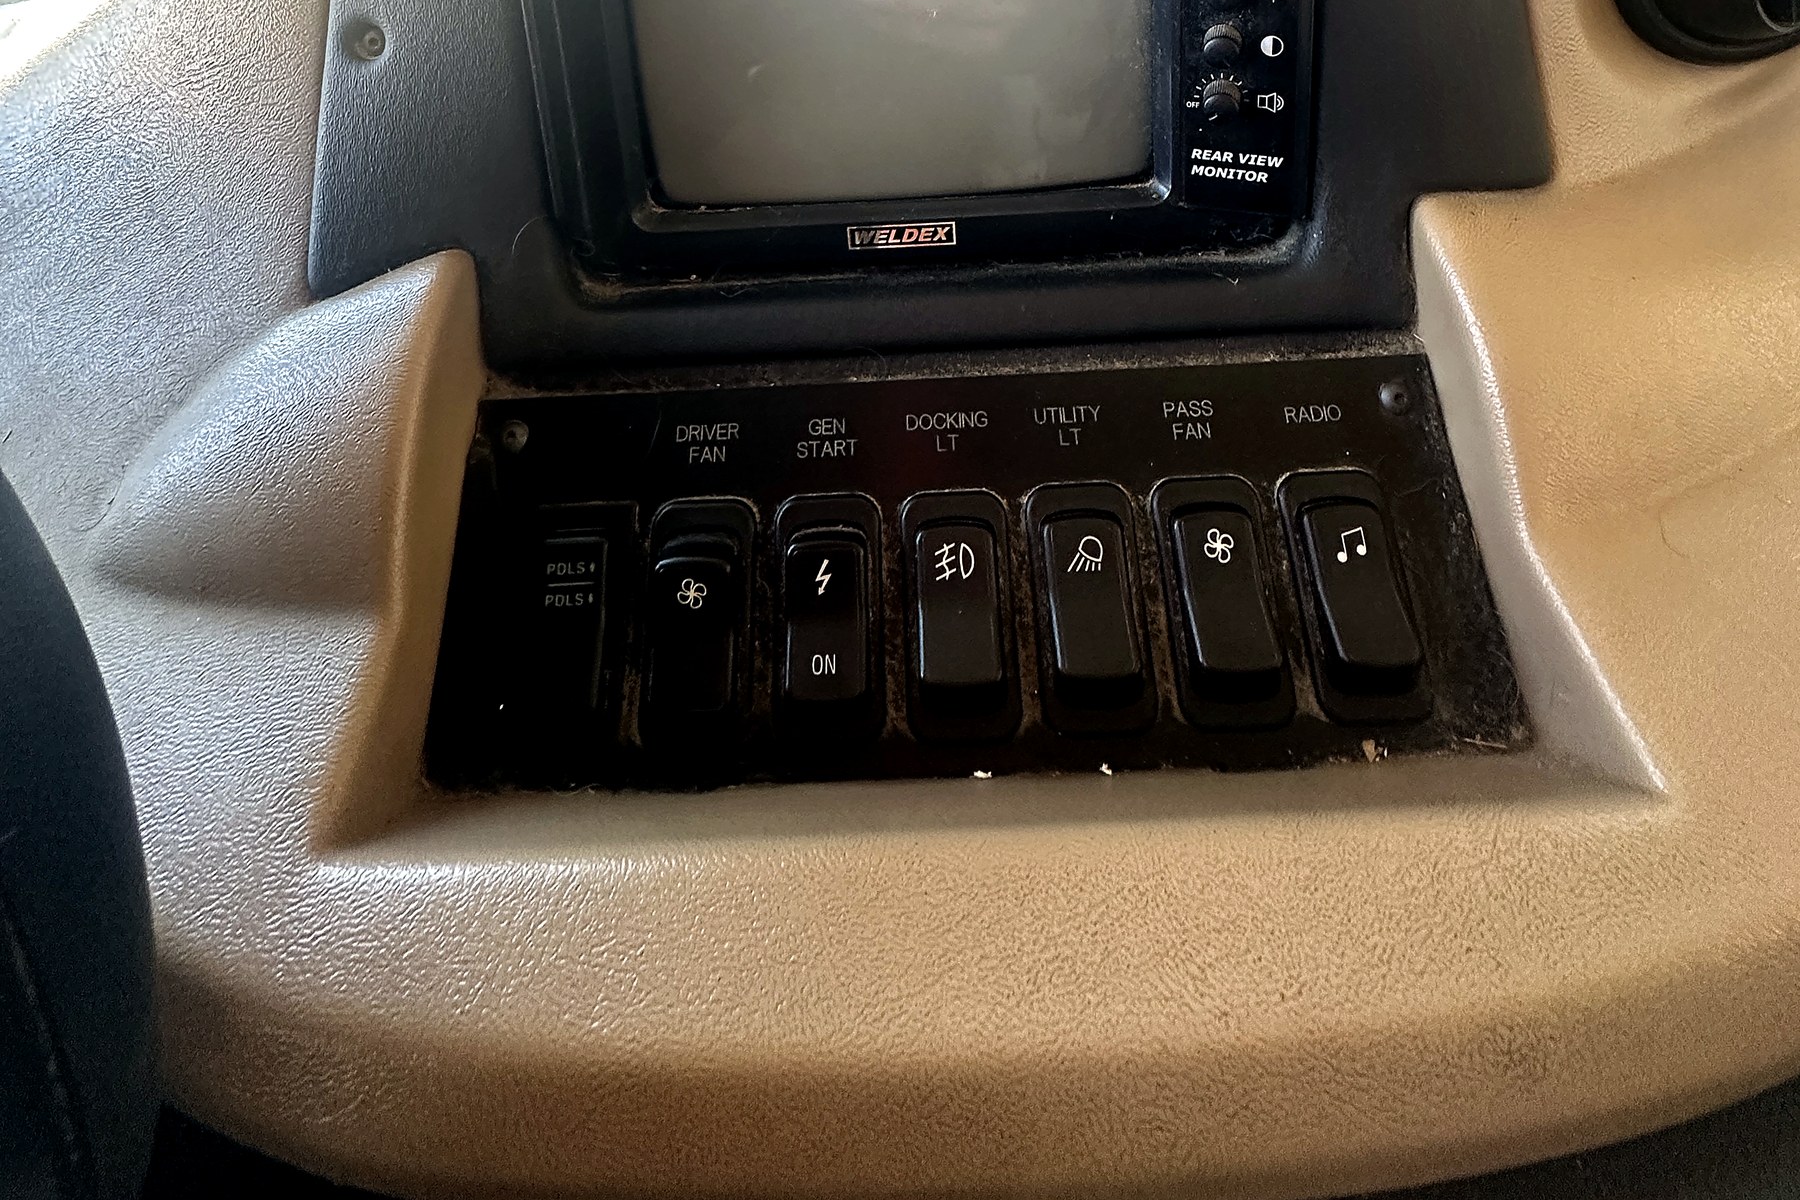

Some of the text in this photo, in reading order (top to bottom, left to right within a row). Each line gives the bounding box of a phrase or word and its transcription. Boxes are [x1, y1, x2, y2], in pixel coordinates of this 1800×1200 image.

[1186, 101, 1200, 109] OFF
[1191, 148, 1284, 168] REAR VIEW
[1191, 164, 1268, 183] MONITOR
[854, 226, 951, 245] WELDEX
[1033, 404, 1101, 425] UTILITY
[1162, 399, 1214, 418] PASS
[1283, 404, 1342, 424] RADIO
[808, 417, 846, 436] GEN
[905, 410, 989, 431] DOCKING
[676, 423, 739, 443] DRIVER
[1058, 428, 1082, 446] LT
[1172, 422, 1211, 441] FAN
[796, 439, 859, 459] START
[936, 434, 960, 452] LT
[688, 445, 726, 464] FAN
[811, 654, 837, 675] ON
